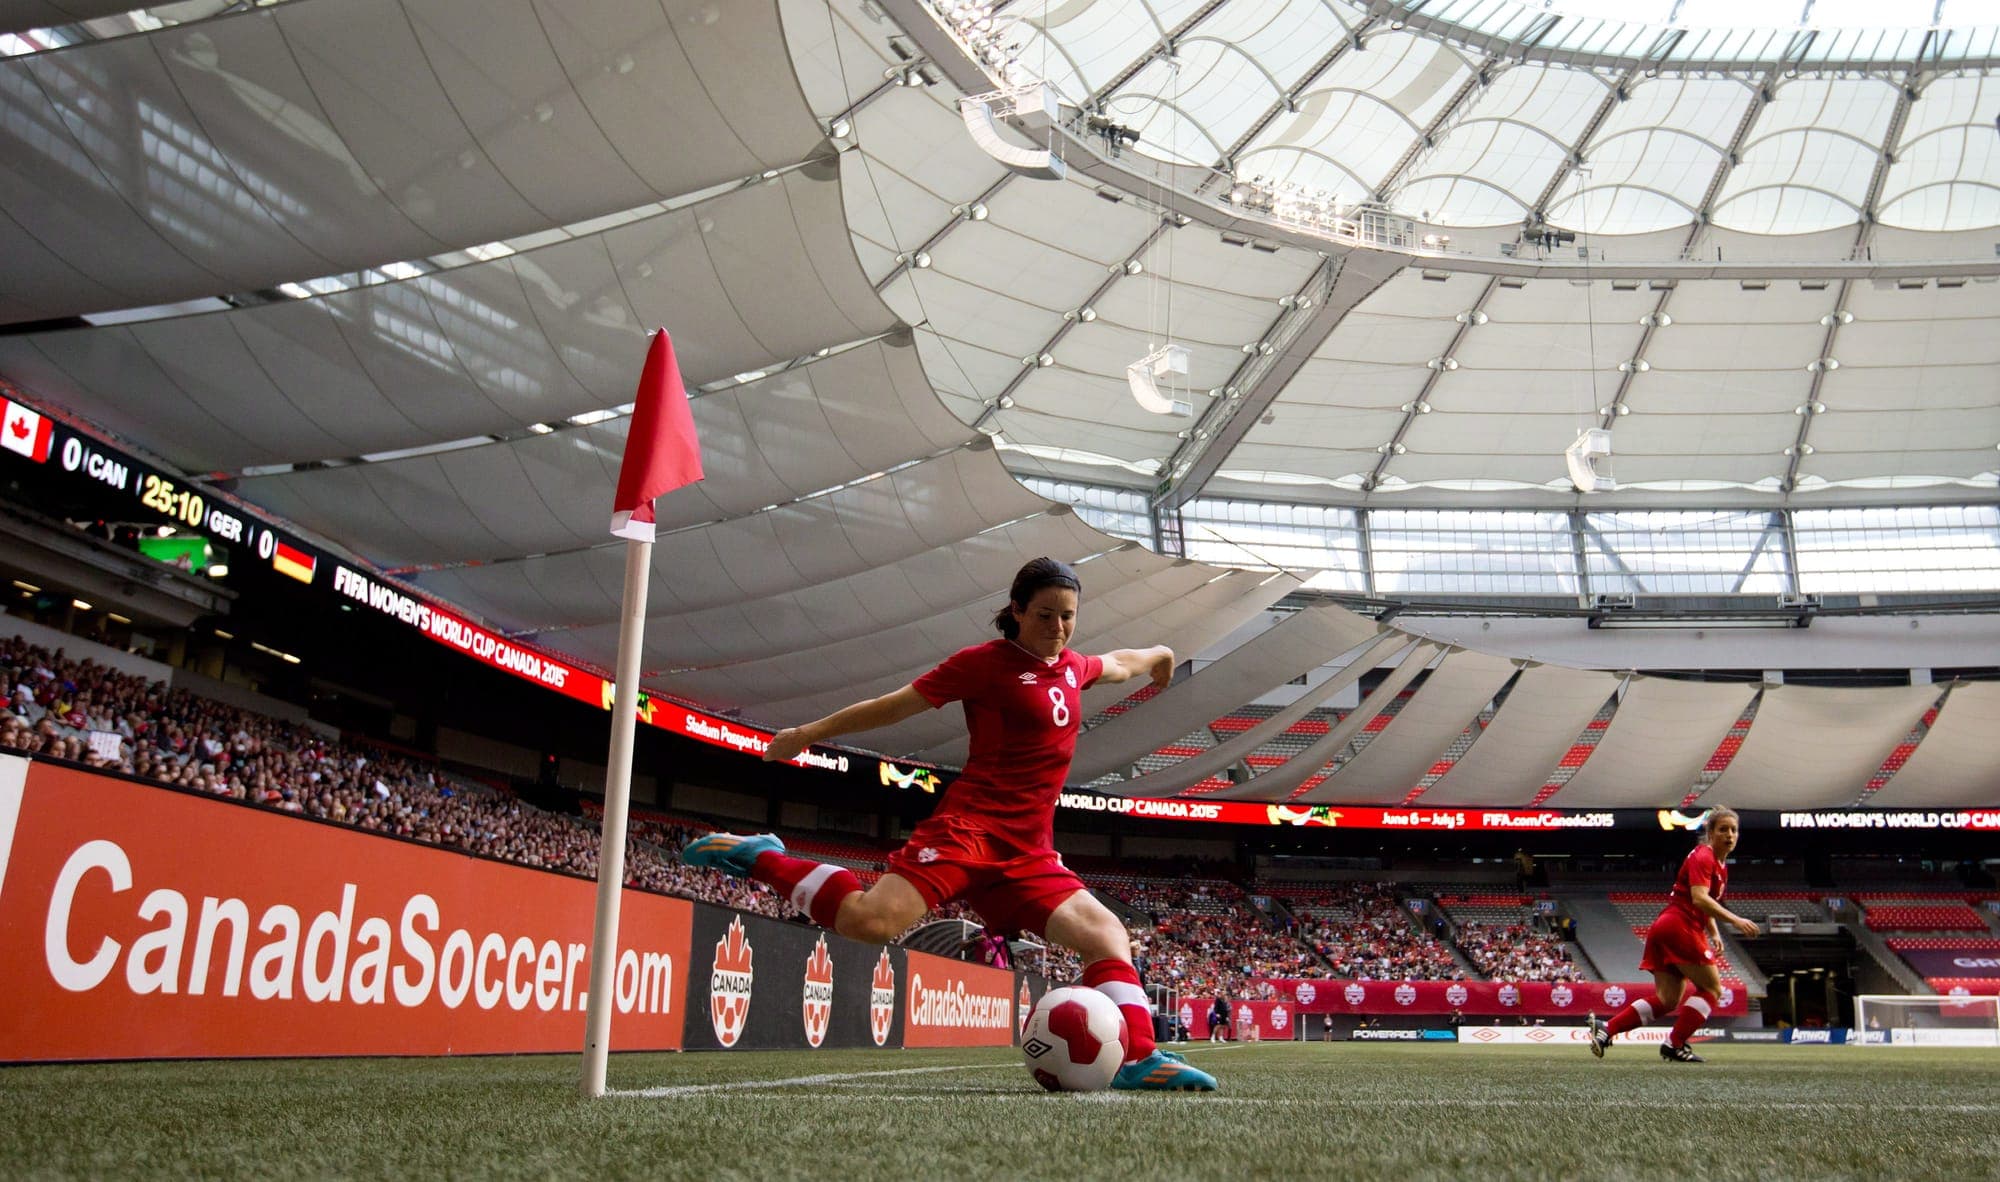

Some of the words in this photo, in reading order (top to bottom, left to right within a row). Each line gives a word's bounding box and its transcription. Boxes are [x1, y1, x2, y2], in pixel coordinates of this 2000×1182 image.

[62, 438, 81, 471] 0
[88, 453, 128, 489] CAN
[142, 475, 203, 527] 25:10
[209, 510, 243, 543] GER
[259, 530, 273, 559] 0
[334, 566, 368, 603] FIFA
[369, 582, 430, 631] WOMEN'S
[430, 611, 472, 649] WORLD
[473, 631, 495, 659] CUP
[495, 643, 541, 680] CANADA
[1047, 686, 1070, 727] 8
[686, 714, 720, 740] Stadium
[721, 725, 762, 751] Passports
[794, 749, 838, 771] eptember
[838, 756, 849, 773] 10
[1060, 793, 1106, 811] WORLD
[1107, 797, 1135, 815] CUP
[1135, 800, 1188, 817] CANADA
[1382, 812, 1409, 826] June
[1410, 812, 1419, 826] 6
[1431, 813, 1455, 829] July
[1456, 815, 1465, 827] 5
[1482, 813, 1614, 828] FIFA.com/Canada2015
[1780, 813, 1815, 828] FIFA
[1815, 813, 1885, 828] WOMEN'S
[1886, 813, 1939, 828] WORLD
[1940, 813, 1971, 828] CUP
[45, 839, 672, 1014] CanadaSoccer.om
[712, 974, 751, 994] CANADA
[803, 983, 832, 1002] CANADA
[871, 990, 894, 1005] CANADA
[911, 973, 1010, 1028] CanadaSoccer.com
[1353, 1029, 1417, 1039] POWERADE
[1791, 1028, 1831, 1043] Amway
